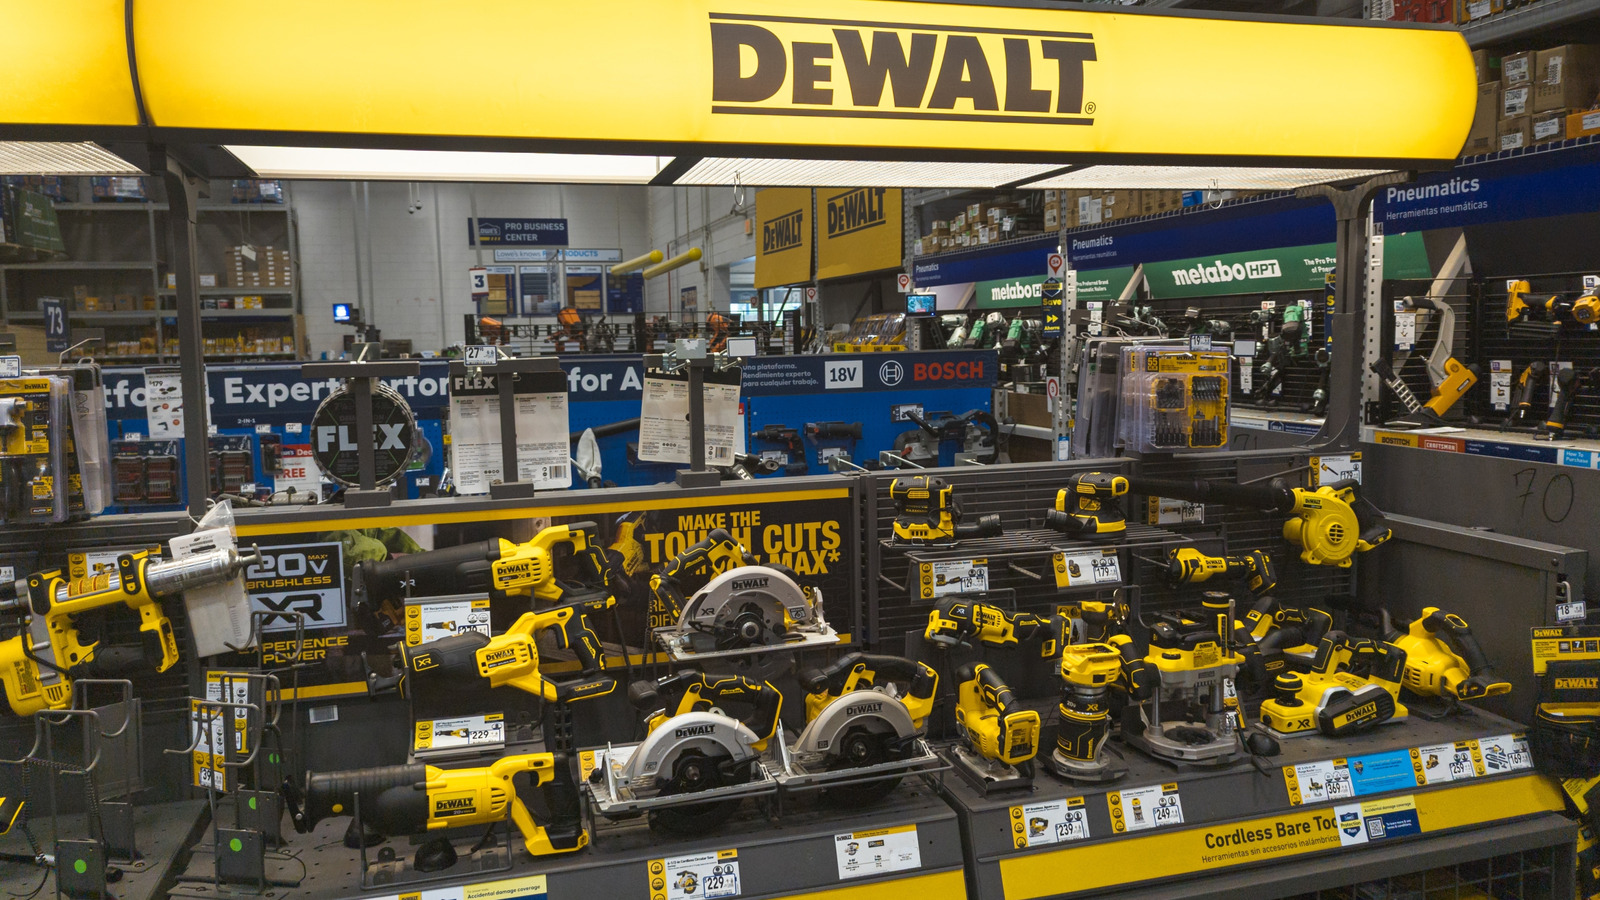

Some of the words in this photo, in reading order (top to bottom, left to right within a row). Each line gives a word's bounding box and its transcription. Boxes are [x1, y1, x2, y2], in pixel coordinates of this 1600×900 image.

[710, 22, 1097, 114] DEWALT
[1387, 177, 1480, 204] Pneumatics
[828, 188, 886, 234] DEWALT
[1387, 206, 1438, 221] Herramientas
[1440, 200, 1488, 214] neumáticas
[505, 223, 523, 231] PRO
[524, 223, 565, 231] BUSINESS
[763, 213, 803, 251] DEWALT
[1073, 235, 1113, 250] Pneumatics
[916, 263, 939, 273] Pneumatics
[1172, 260, 1246, 285] metabo
[1249, 262, 1276, 276] HPT
[475, 275, 485, 288] 3
[992, 282, 1033, 301] metabo
[1043, 298, 1062, 306] Save
[47, 307, 64, 336] 73
[757, 363, 797, 371] plataforma.
[830, 367, 857, 382] 18V
[914, 361, 984, 381] BOSCH
[568, 367, 613, 393] for
[743, 371, 784, 379] Rendimiento
[785, 371, 811, 379] experto
[454, 377, 496, 391] FLEX
[760, 379, 791, 388] cualquier
[792, 379, 818, 388] trabajo.
[317, 423, 406, 453] FLX
[1381, 437, 1411, 446] BOSTITCH
[1425, 441, 1456, 451] CRAFTSMAN
[1513, 468, 1574, 523] 70
[678, 513, 726, 531] MAKE
[730, 511, 761, 527] THE
[645, 526, 752, 564] TOUH
[763, 520, 841, 555] CUTS
[247, 553, 306, 579] 20
[309, 560, 328, 574] V
[497, 564, 529, 575] DEWALT
[247, 576, 332, 590] BRUSHLESS
[732, 578, 769, 590] DEWALT
[257, 592, 325, 626] XR
[701, 608, 715, 616] XR
[1534, 629, 1563, 637] DEWALT
[238, 636, 349, 654] PERIENCE
[486, 648, 515, 662] DEWALT
[418, 657, 432, 668] XR
[1555, 678, 1599, 689] DEWALT
[847, 702, 883, 715] DEWALT
[1087, 703, 1099, 711] XR
[1346, 703, 1376, 722] DEWALT
[1297, 719, 1310, 729] XR
[472, 730, 489, 740] 229
[676, 724, 716, 739] DEWALT
[1328, 783, 1340, 794] 369
[436, 797, 474, 810] DEWALT
[1157, 808, 1170, 819] 249
[1059, 824, 1073, 836] 239
[1341, 820, 1362, 828] Protection
[1205, 825, 1273, 849] Cordless
[1276, 820, 1311, 837] Bare
[1202, 850, 1249, 864] Herramientas
[1251, 847, 1261, 856] sin
[1262, 841, 1298, 854] accesorios
[1299, 834, 1341, 848] inalámbricos
[707, 876, 724, 890] 229
[468, 891, 495, 899] Accidental
[496, 888, 516, 896] damage
[517, 885, 541, 893] coverage
